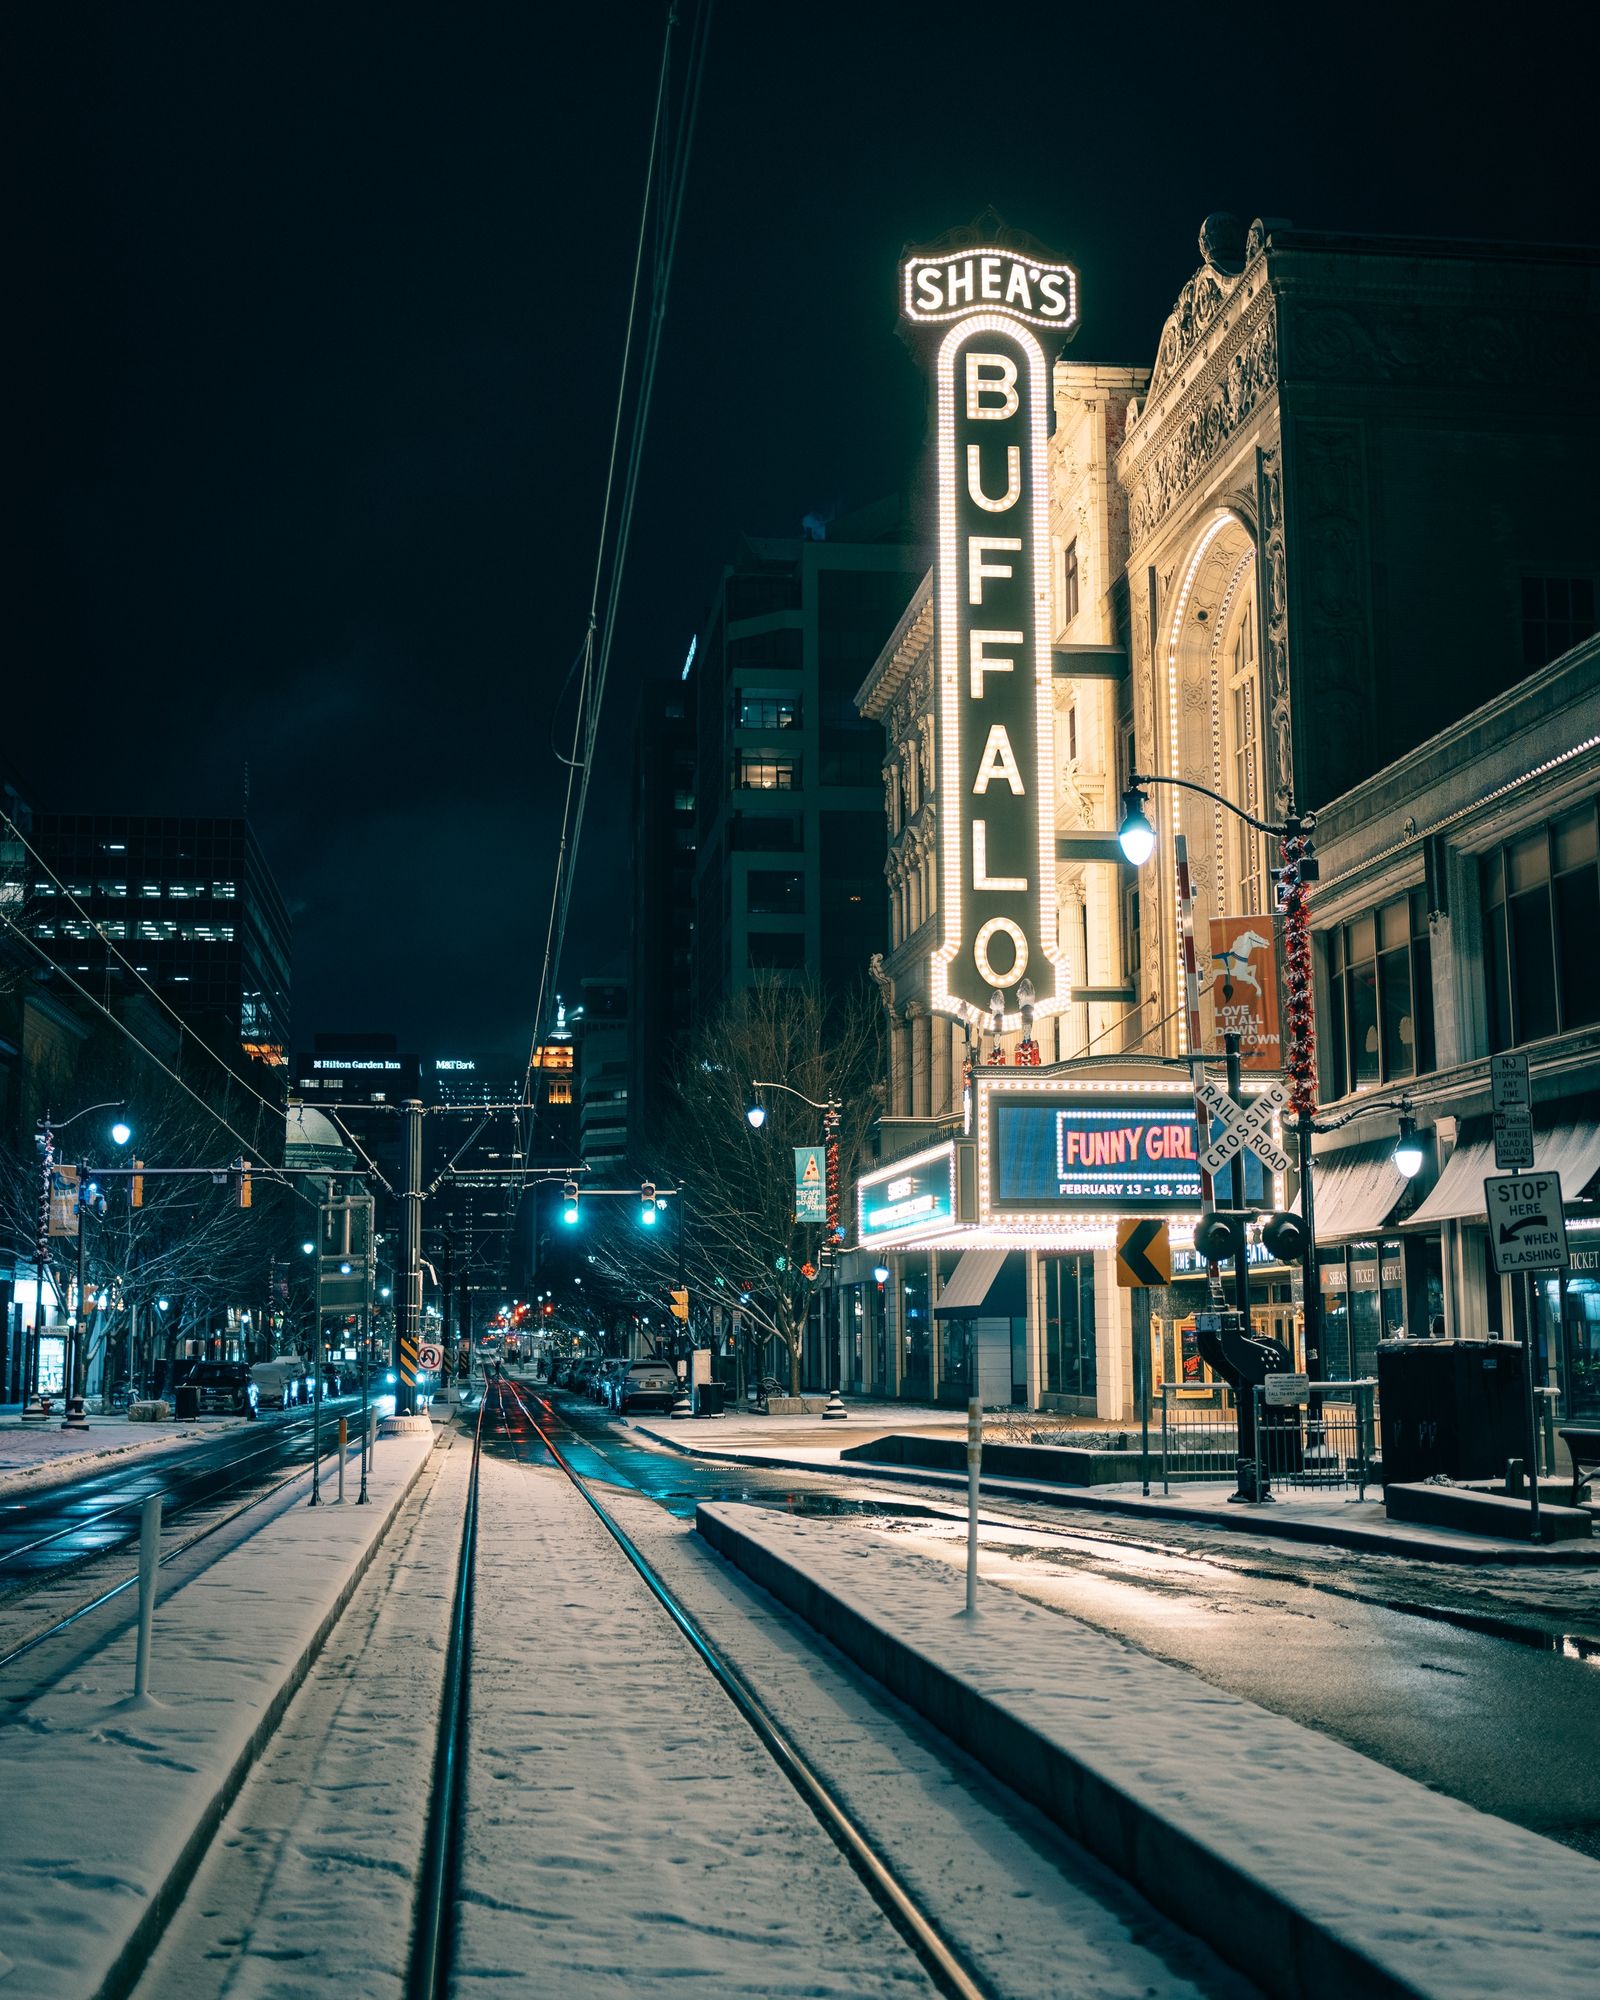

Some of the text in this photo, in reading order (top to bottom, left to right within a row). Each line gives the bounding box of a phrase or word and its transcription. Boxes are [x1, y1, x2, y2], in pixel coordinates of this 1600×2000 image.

[916, 257, 1067, 316] SHEA'S
[966, 352, 1029, 989] BUFFALO
[1215, 1005, 1249, 1017] LOVE
[1225, 1014, 1264, 1026] IT ALL
[1216, 1024, 1258, 1036] DOWN
[1240, 1034, 1280, 1045] TOWN
[322, 1060, 401, 1069] Hilton Garden Inn
[436, 1060, 475, 1070] M&T Bank
[1502, 1058, 1516, 1069] NO
[1494, 1071, 1526, 1079] STOPPING
[1503, 1080, 1517, 1088] ANY
[1503, 1090, 1519, 1098] TIME
[1495, 1116, 1506, 1127] NO
[1201, 1086, 1287, 1171] RAIL ROAD
[1207, 1089, 1283, 1167] CROSSING
[1507, 1130, 1528, 1138] MINUTE
[1066, 1125, 1197, 1166] FUNNY GIRL
[1498, 1139, 1530, 1148] LOAD &
[1498, 1148, 1531, 1156] UNLOAD
[1059, 1184, 1124, 1195] FEBRUARY
[1127, 1184, 1142, 1195] 13
[1154, 1184, 1173, 1197] 18,
[1498, 1181, 1548, 1202] STOP
[1509, 1203, 1542, 1216] HERE
[1523, 1232, 1558, 1246] WHEN
[1175, 1252, 1190, 1269] THE
[1502, 1248, 1561, 1264] FLASHING
[1569, 1251, 1599, 1270] TICKET
[1355, 1268, 1375, 1283] TICKET
[1381, 1265, 1401, 1281] OFFICE
